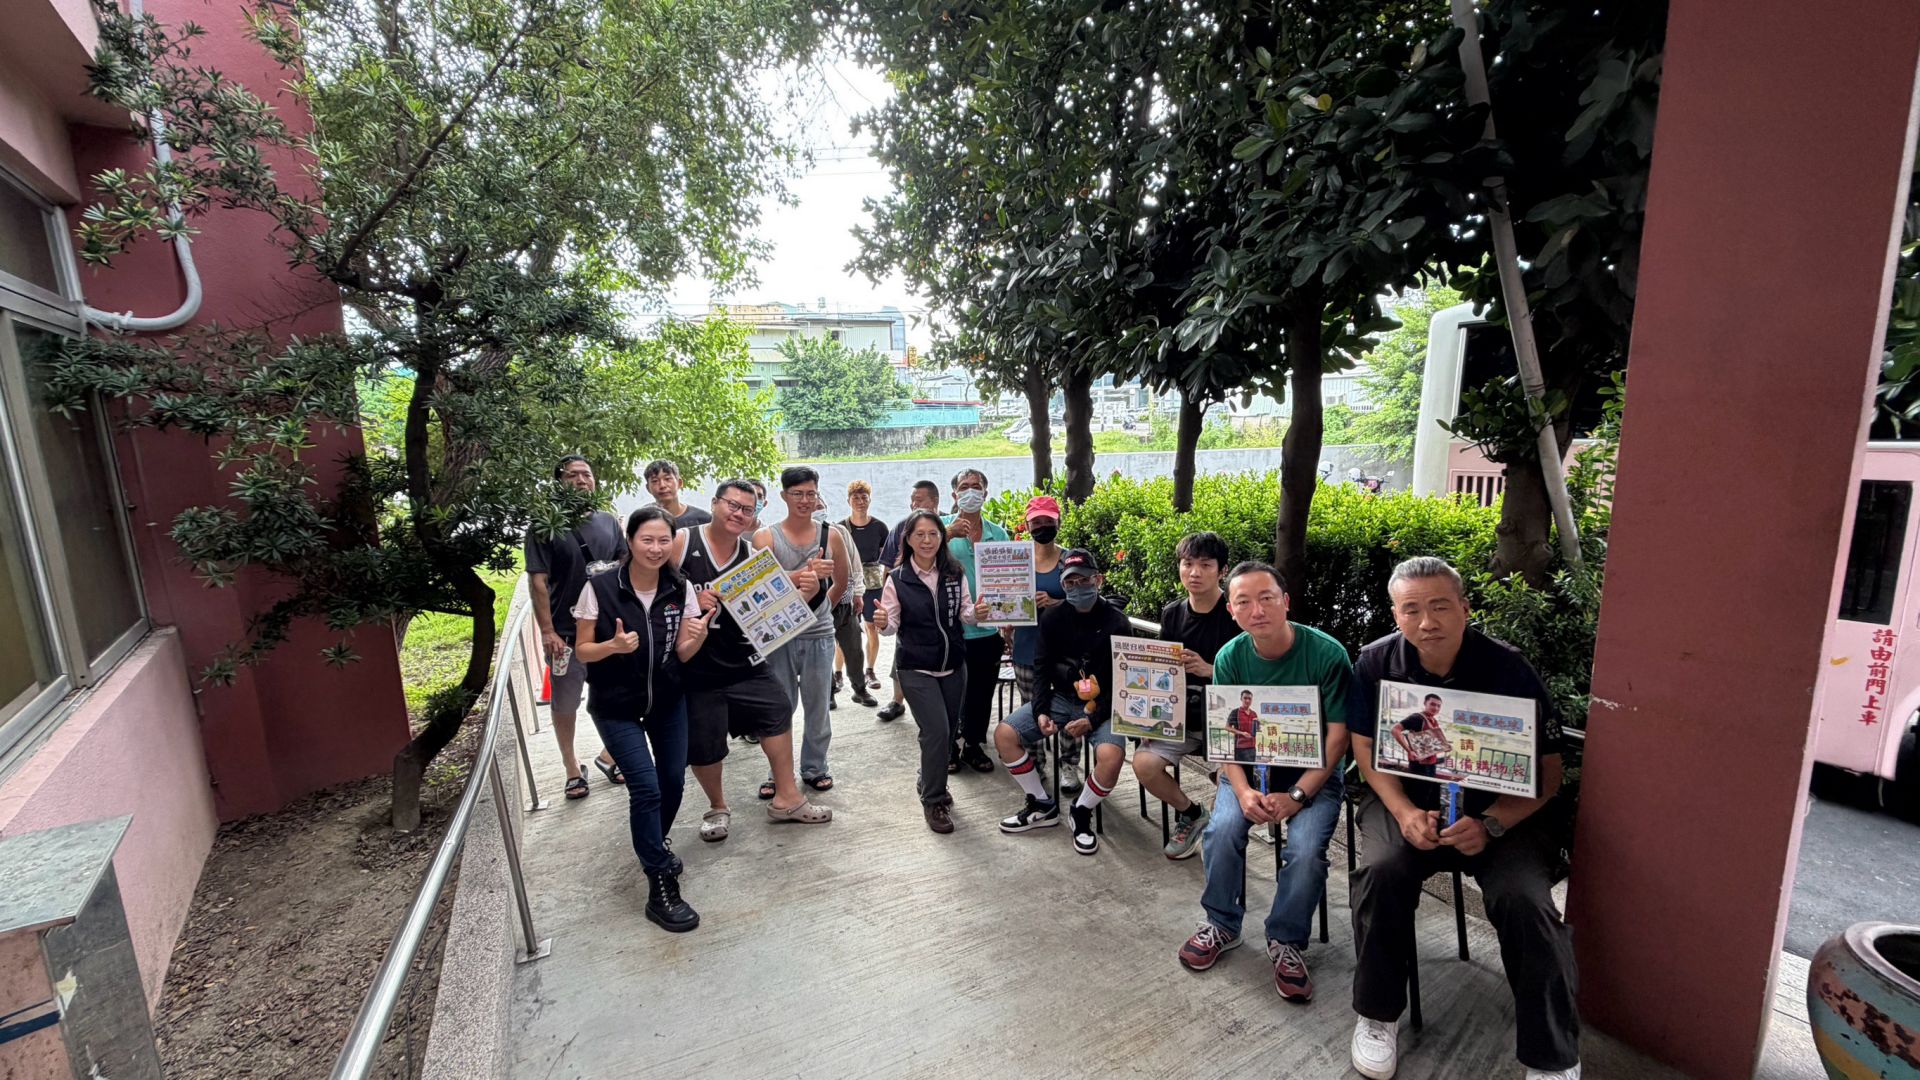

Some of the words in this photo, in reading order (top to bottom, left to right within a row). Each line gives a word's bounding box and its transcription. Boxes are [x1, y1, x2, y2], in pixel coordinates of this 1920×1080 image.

[1858, 629, 1898, 726] 請由前門上車
[1267, 726, 1278, 737] 請
[1460, 738, 1475, 752] 請
[1445, 755, 1526, 778] 自備購物袋
